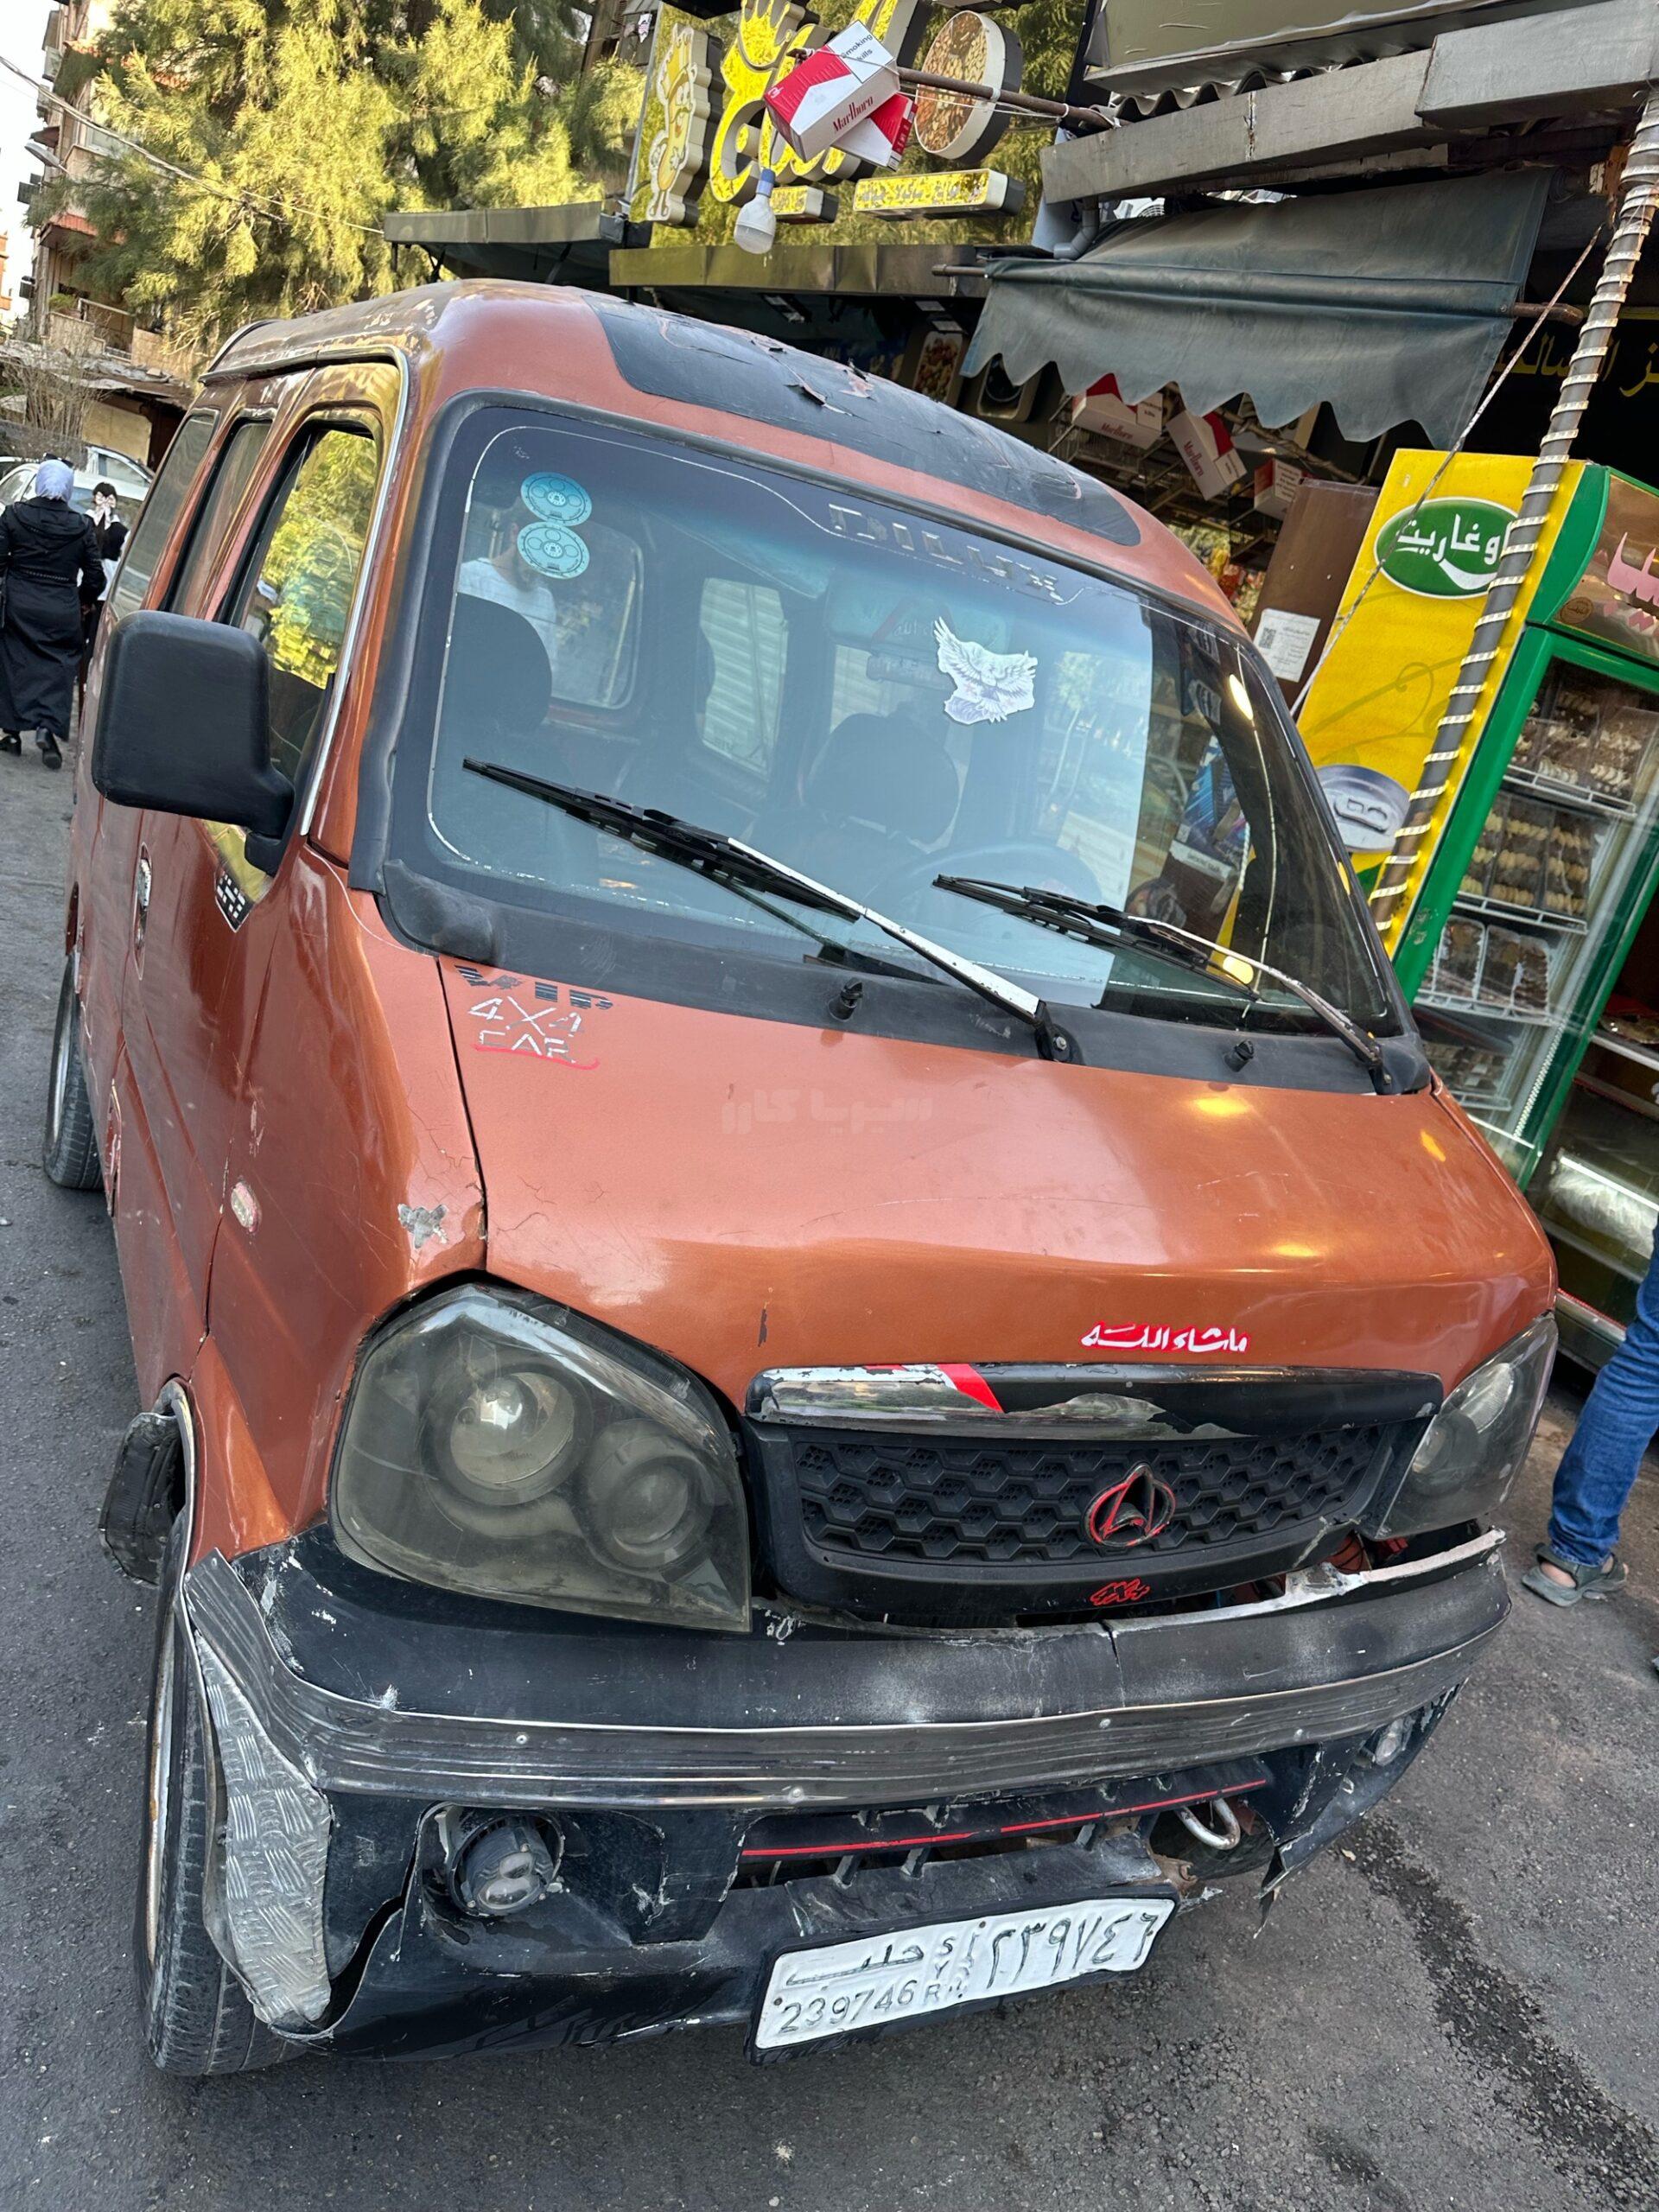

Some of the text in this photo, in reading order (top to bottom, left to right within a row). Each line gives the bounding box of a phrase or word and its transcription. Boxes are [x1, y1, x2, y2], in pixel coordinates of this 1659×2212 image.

[833, 96, 874, 133] Marlboro
[1081, 1322, 1170, 1351] الله
[778, 1980, 918, 2035] 239746
